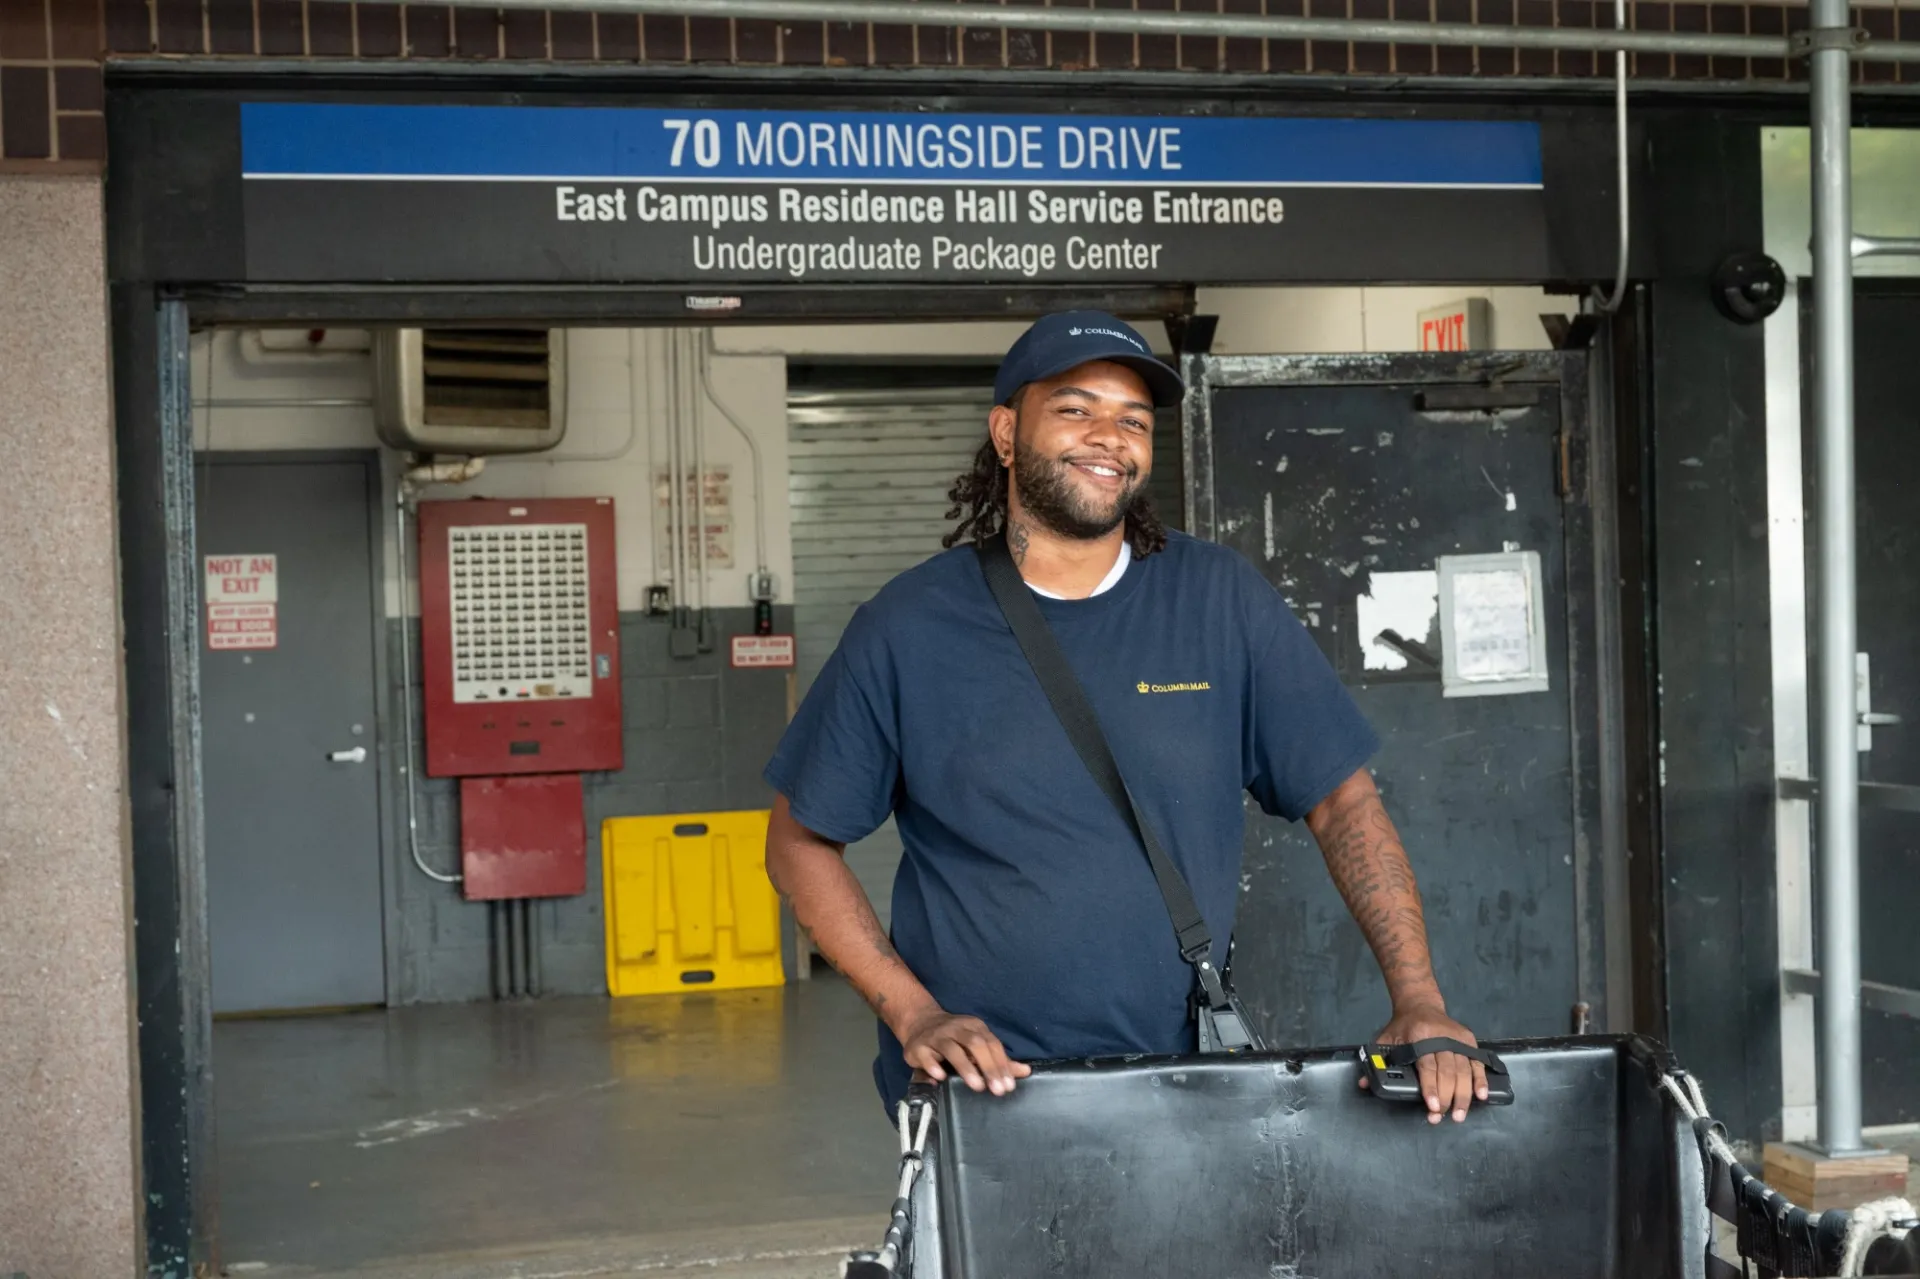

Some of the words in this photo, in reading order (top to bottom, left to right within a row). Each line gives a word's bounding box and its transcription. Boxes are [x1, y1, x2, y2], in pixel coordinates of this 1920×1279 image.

[663, 118, 721, 168] 70
[736, 122, 1043, 169] MORNINGSIDE
[1058, 126, 1182, 170] DRIVE
[556, 186, 628, 222] East
[636, 187, 768, 229] Campus
[778, 188, 945, 223] Residence
[955, 190, 1018, 223] Hall
[1028, 190, 1143, 223] Service
[1154, 191, 1284, 224] Entrance
[692, 235, 922, 278] Undergraduate
[932, 236, 1057, 277] Package
[1065, 236, 1163, 271] Center
[207, 559, 243, 576] NOT
[249, 558, 274, 575] AN
[221, 577, 260, 594] EXIT
[1189, 681, 1211, 691] MAIL
